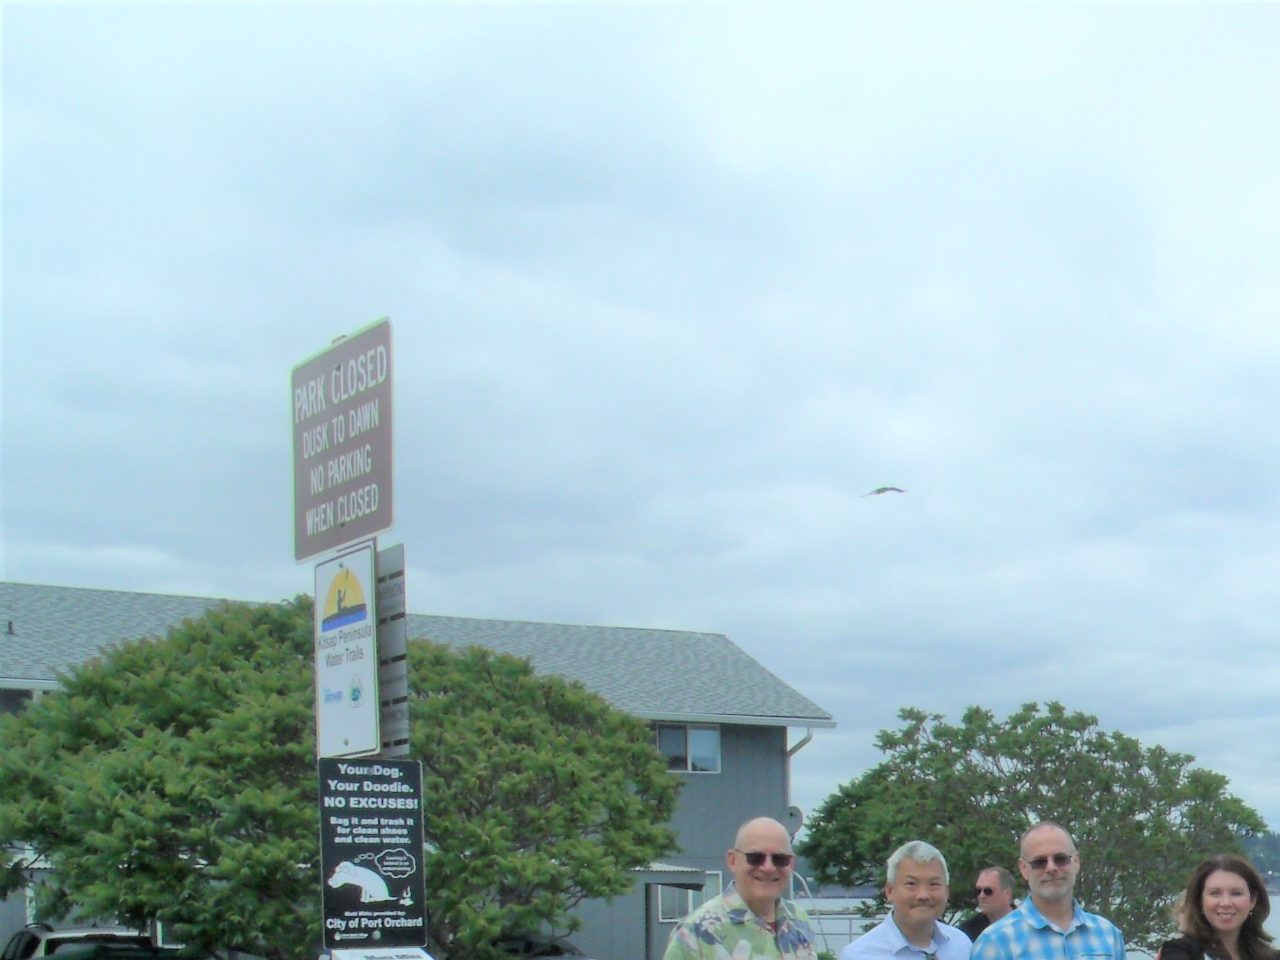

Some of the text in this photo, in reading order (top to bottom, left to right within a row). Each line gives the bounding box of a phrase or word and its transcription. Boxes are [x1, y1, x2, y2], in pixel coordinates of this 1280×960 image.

[295, 345, 387, 424] PARK CLOSED
[304, 398, 379, 458] DUSK TO DAWN
[311, 444, 371, 495] NO PARKING
[306, 484, 379, 536] WHEN CLOSED
[339, 625, 372, 644] Peninsula
[326, 646, 363, 667] Water Trails
[339, 764, 403, 779] Your Dog.
[328, 781, 413, 793] Your Doodie.
[324, 798, 418, 810] NO EXCUSES!
[330, 817, 349, 826] Bag
[352, 817, 359, 825] it
[381, 818, 404, 826] trash
[407, 818, 414, 826] it
[337, 827, 408, 836] for clean shoes
[335, 836, 411, 845] and clean water.
[326, 917, 423, 930] City of Port Orchard
